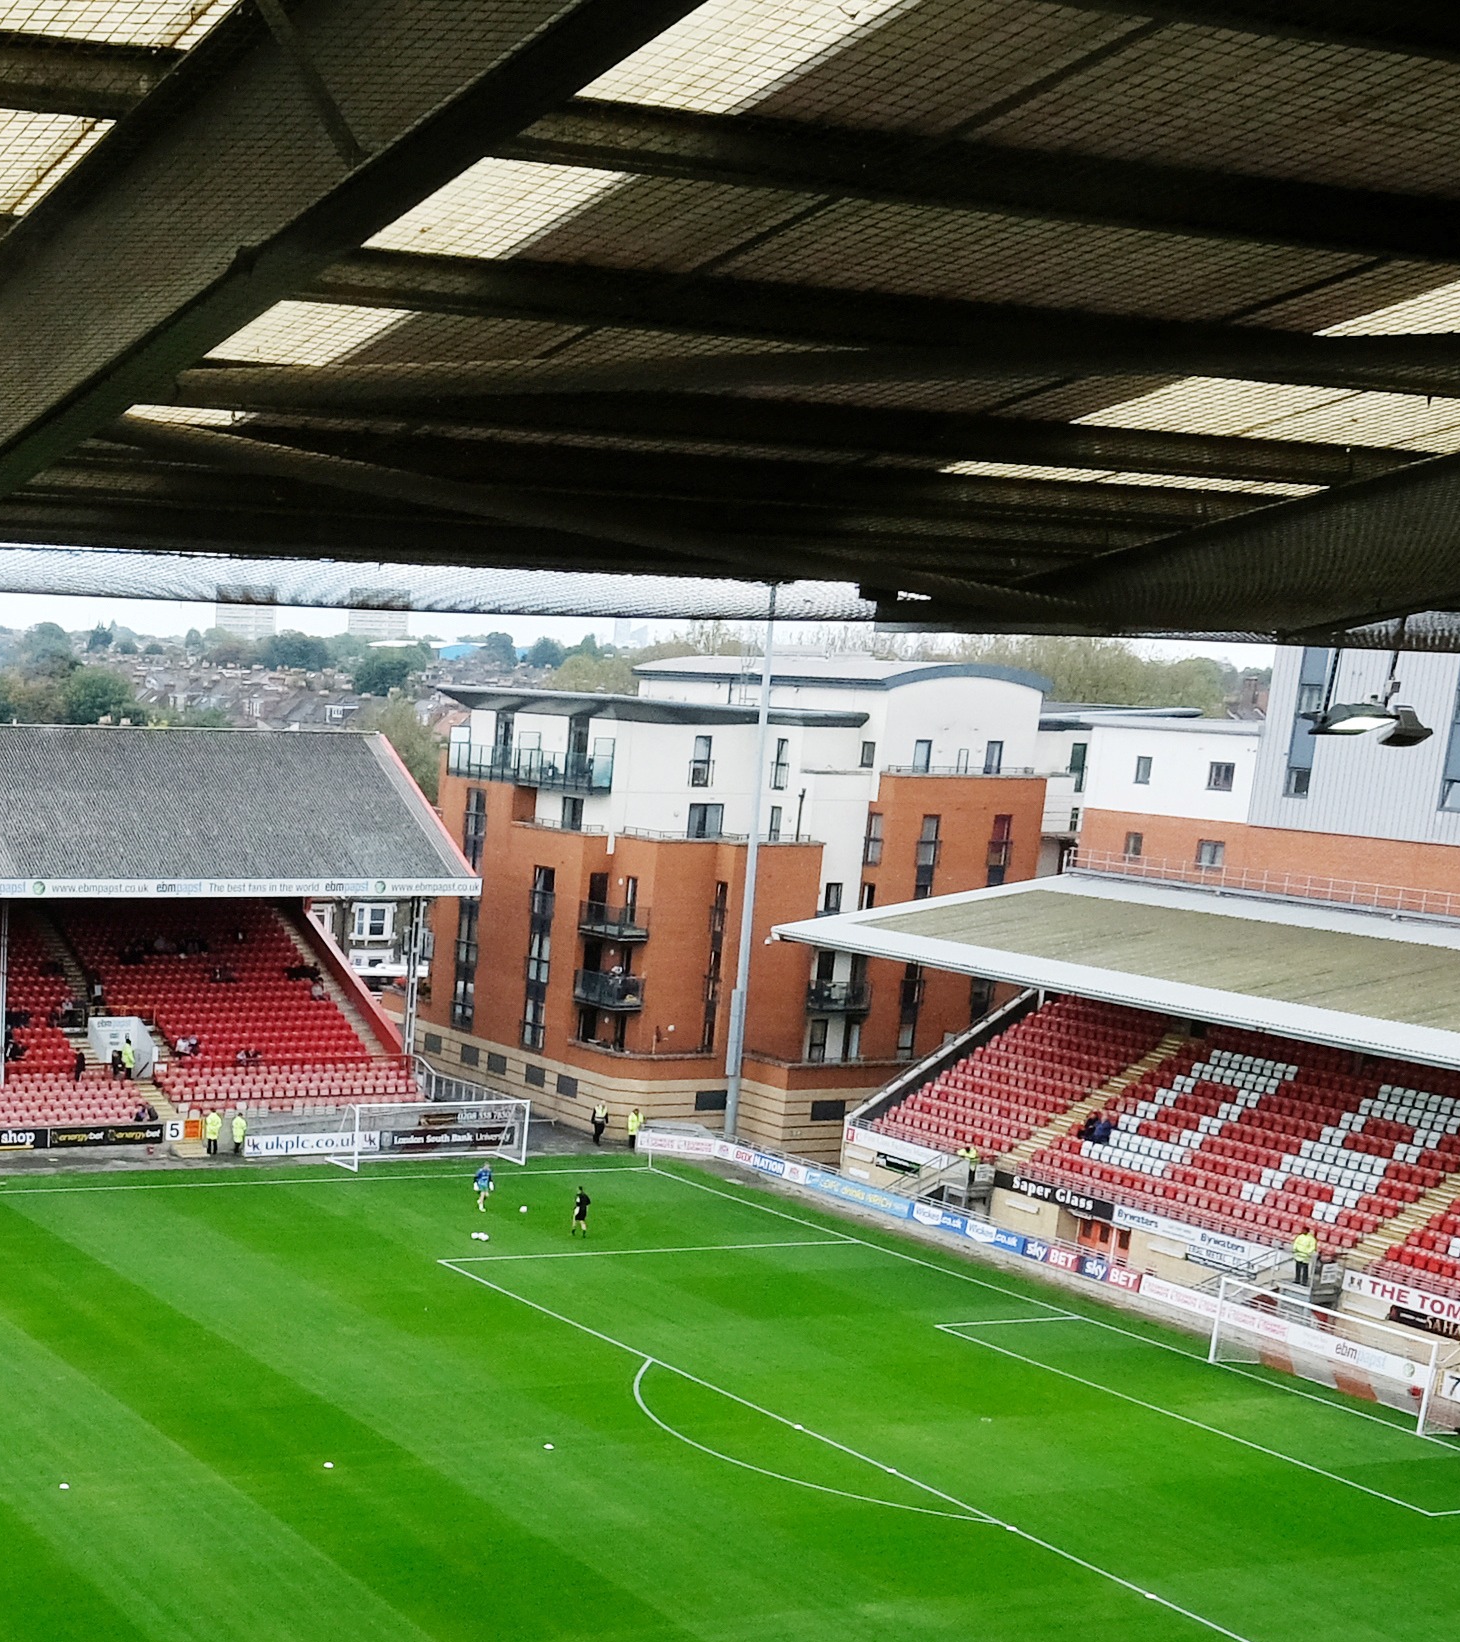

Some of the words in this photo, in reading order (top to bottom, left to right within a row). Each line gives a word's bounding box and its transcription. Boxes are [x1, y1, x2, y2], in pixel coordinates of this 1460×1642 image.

[2, 1130, 36, 1147] shop
[169, 1122, 179, 1138] 5
[753, 1153, 784, 1174] NATION
[1012, 1176, 1051, 1199] Saper
[1054, 1188, 1093, 1211] Glass
[1116, 1207, 1159, 1229] Bywaters
[1026, 1239, 1048, 1262] sky
[1049, 1249, 1077, 1269] BET
[1200, 1232, 1246, 1254] Bywaters
[1084, 1258, 1108, 1281] sky
[1109, 1268, 1139, 1289] BET
[1368, 1280, 1409, 1305] THE
[1450, 1375, 1460, 1395] 7
